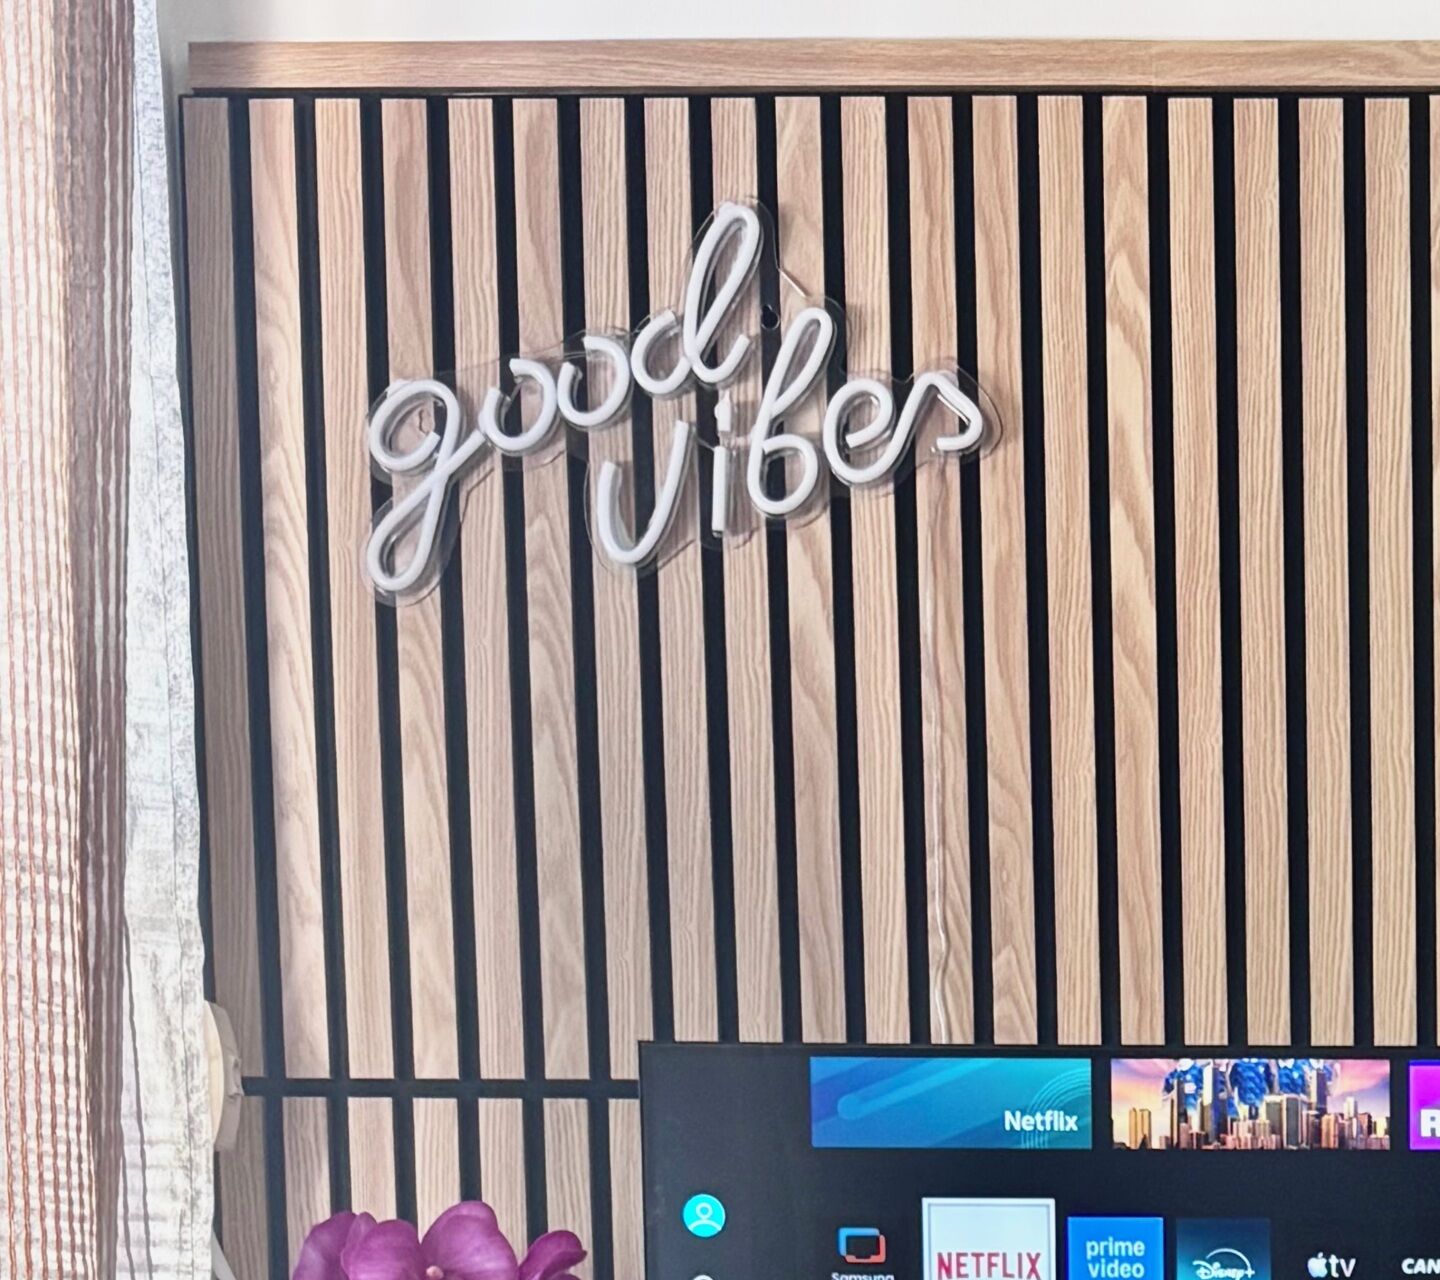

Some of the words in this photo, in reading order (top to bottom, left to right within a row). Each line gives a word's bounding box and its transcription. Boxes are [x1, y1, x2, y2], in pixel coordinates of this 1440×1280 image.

[367, 204, 760, 592] good
[600, 307, 984, 565] vibes
[1004, 1110, 1078, 1131] Netflix
[1086, 1237, 1145, 1259] prime
[937, 1252, 1042, 1280] NETFLIX
[1088, 1259, 1145, 1279] video
